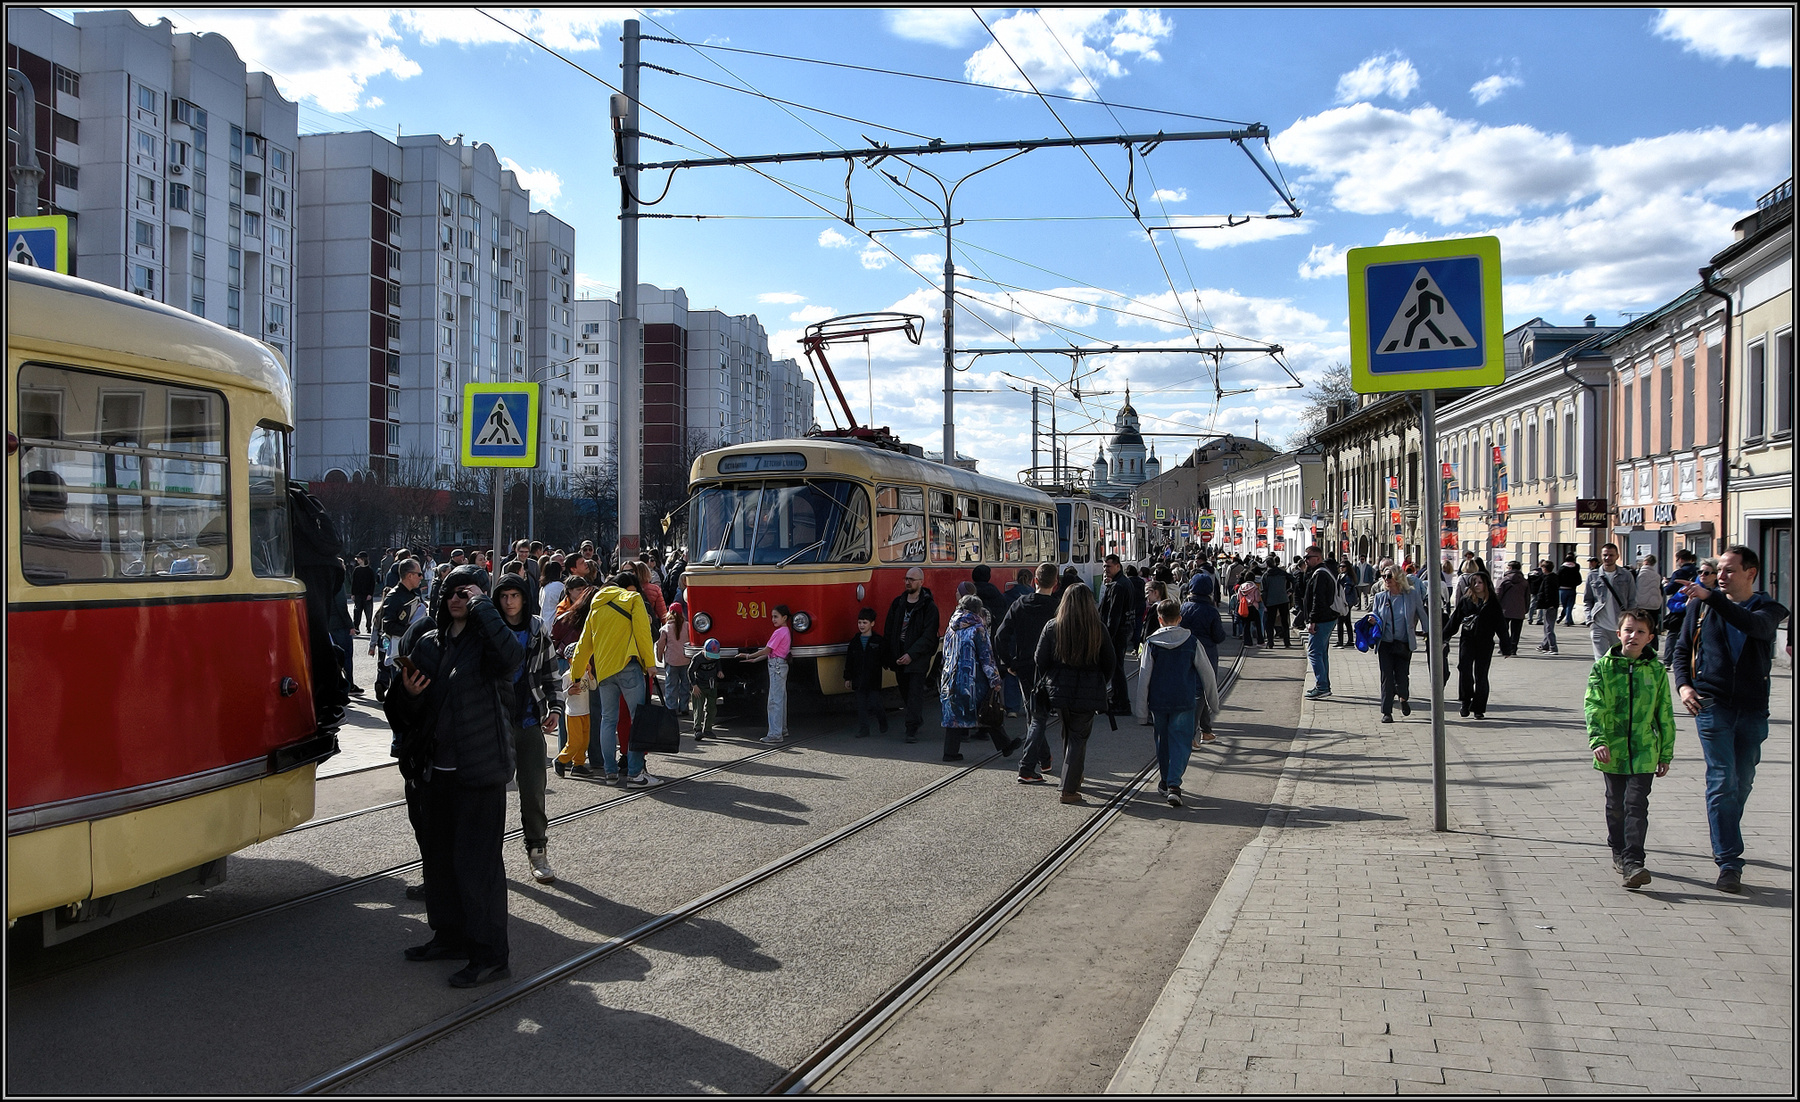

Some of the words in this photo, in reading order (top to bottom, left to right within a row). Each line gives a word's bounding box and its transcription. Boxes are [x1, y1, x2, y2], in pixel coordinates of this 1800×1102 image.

[753, 456, 762, 471] 7
[1578, 512, 1606, 521] НОТАРИУС
[1653, 504, 1675, 522] ТАБАК
[736, 601, 767, 619] 481
